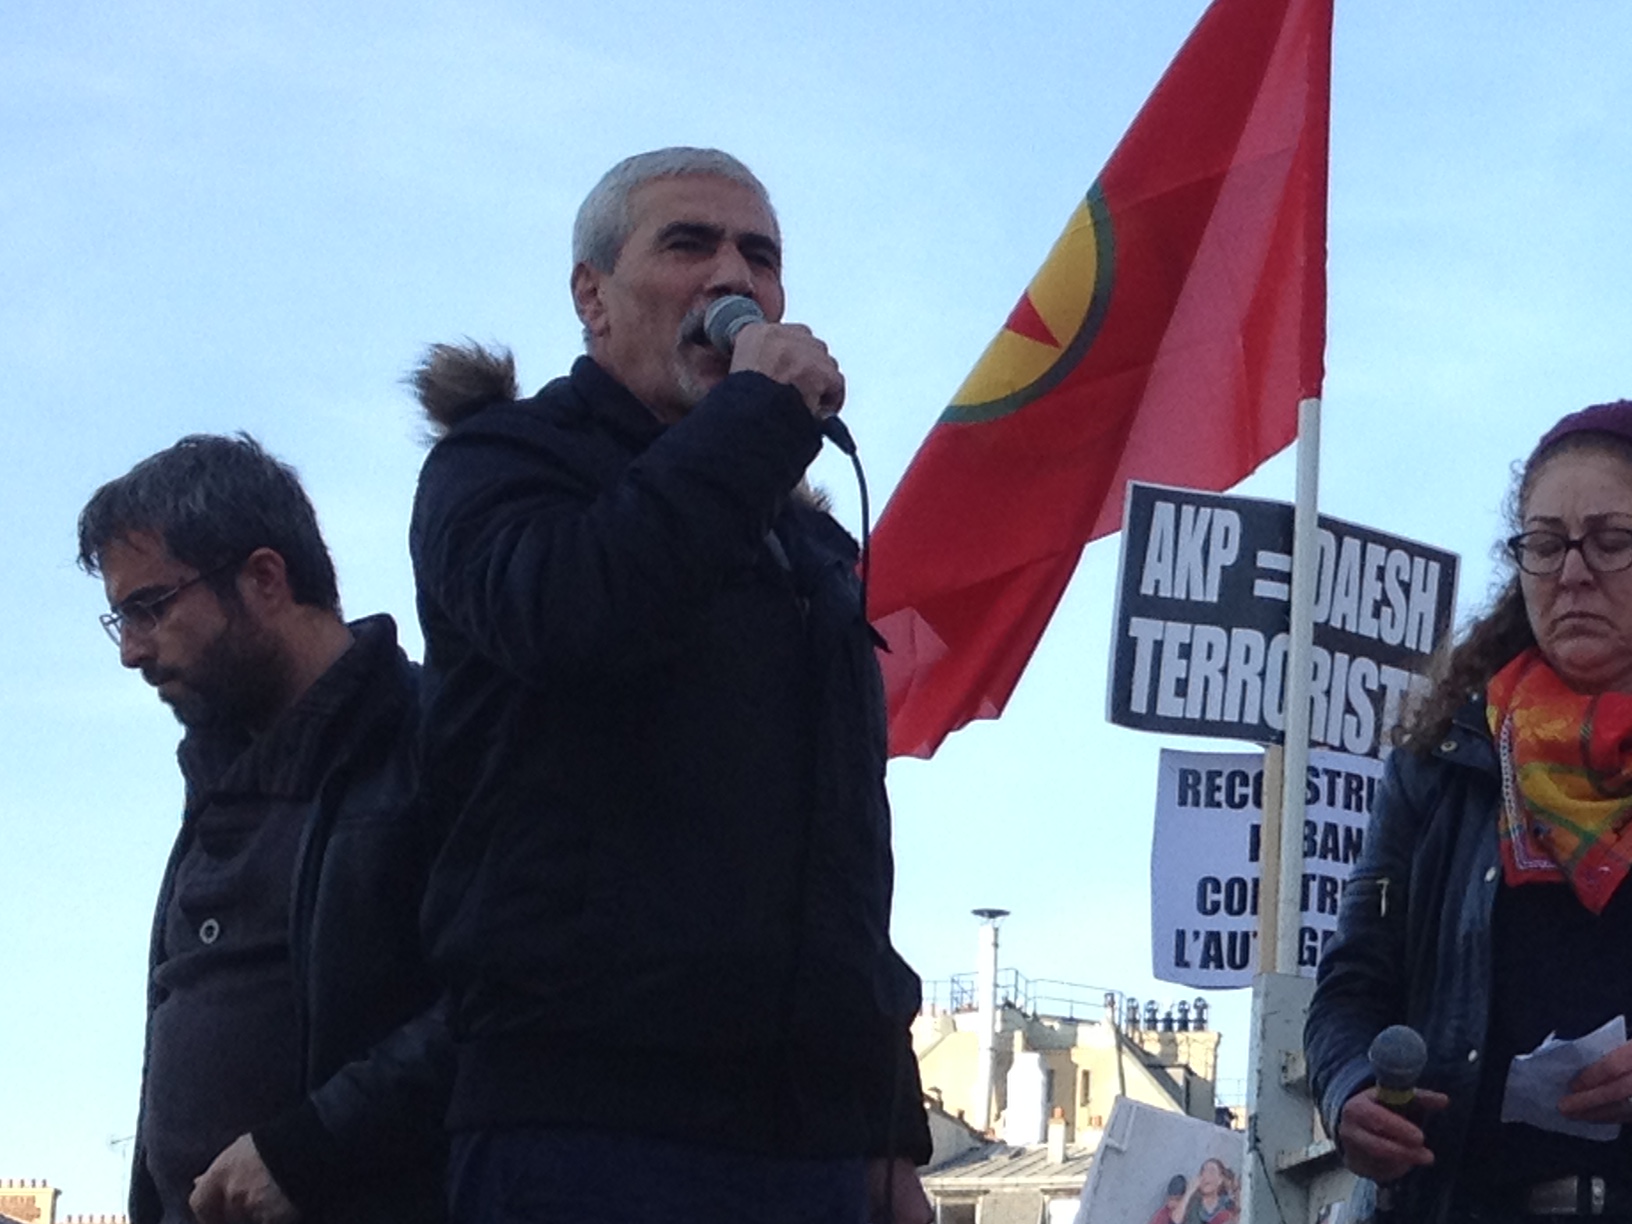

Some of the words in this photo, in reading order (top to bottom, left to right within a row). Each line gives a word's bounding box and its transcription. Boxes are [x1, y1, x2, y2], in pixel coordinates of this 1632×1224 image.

[1140, 501, 1241, 603] AKP
[1253, 550, 1292, 601] =
[1313, 528, 1441, 655] DAESH
